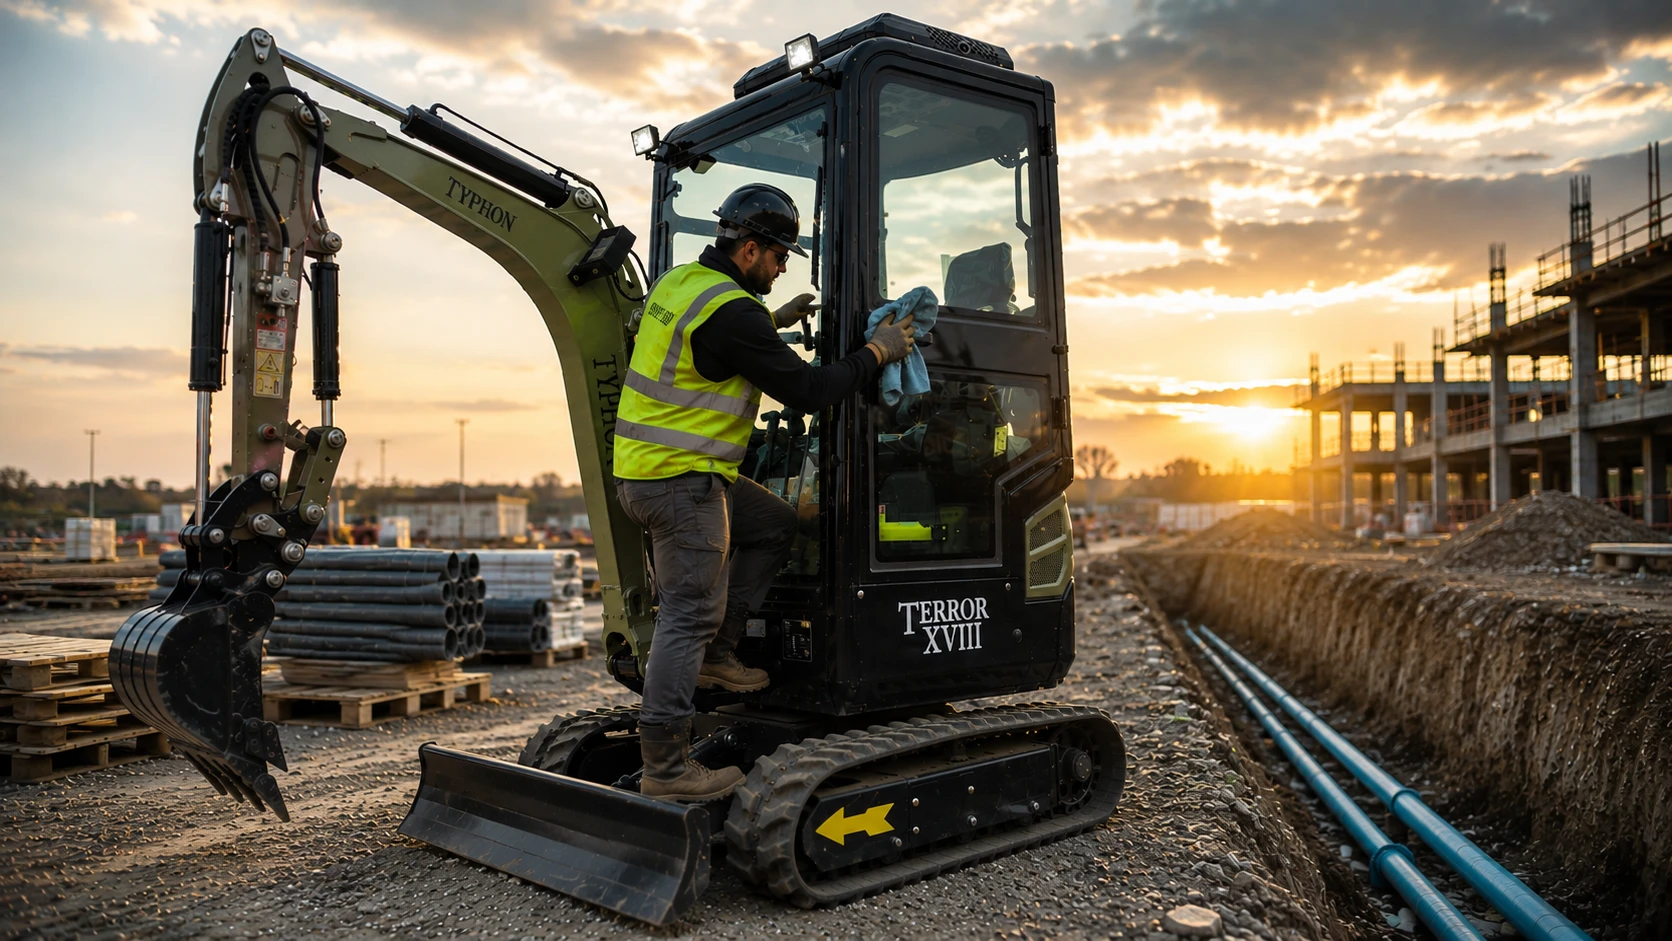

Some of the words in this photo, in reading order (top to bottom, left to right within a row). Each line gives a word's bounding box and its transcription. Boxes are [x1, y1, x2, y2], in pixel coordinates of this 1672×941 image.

[445, 176, 518, 232] TYPHON
[898, 597, 990, 635] TERROR
[922, 622, 982, 654] XVIII
